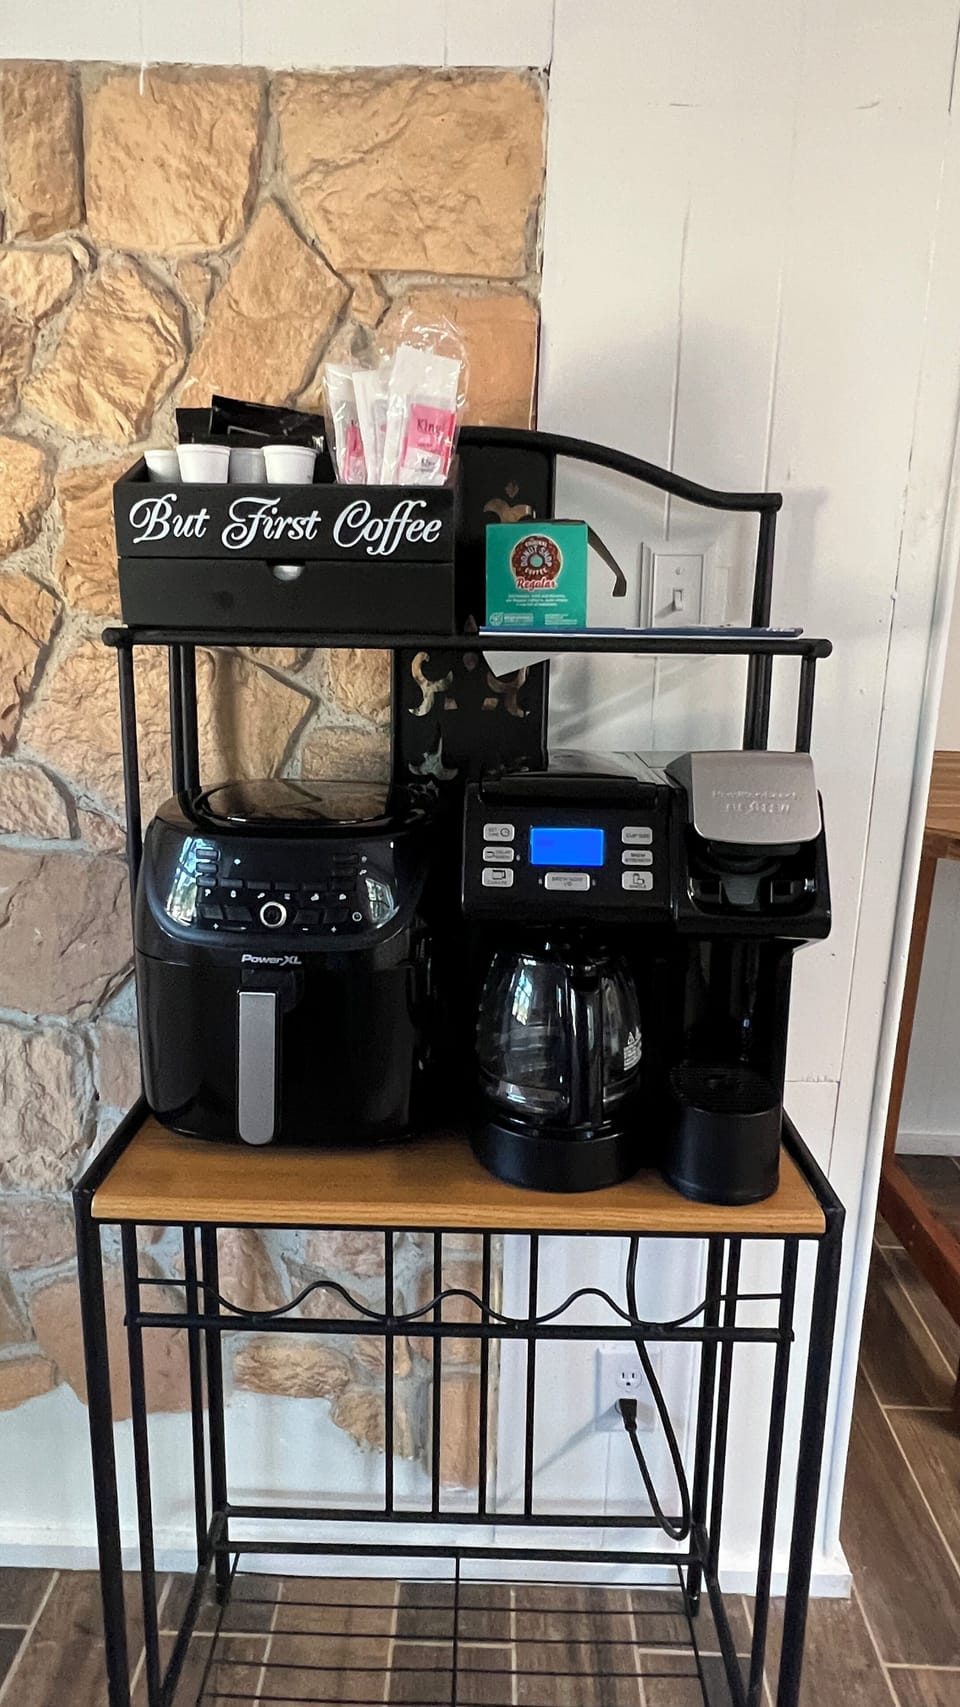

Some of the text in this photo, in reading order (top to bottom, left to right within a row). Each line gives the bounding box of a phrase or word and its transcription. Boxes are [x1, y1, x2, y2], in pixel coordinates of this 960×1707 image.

[129, 493, 443, 556] But First Coffee
[520, 545, 553, 567] DONUT SHOP
[516, 577, 557, 591] Regular
[241, 953, 303, 967] PowerXL
